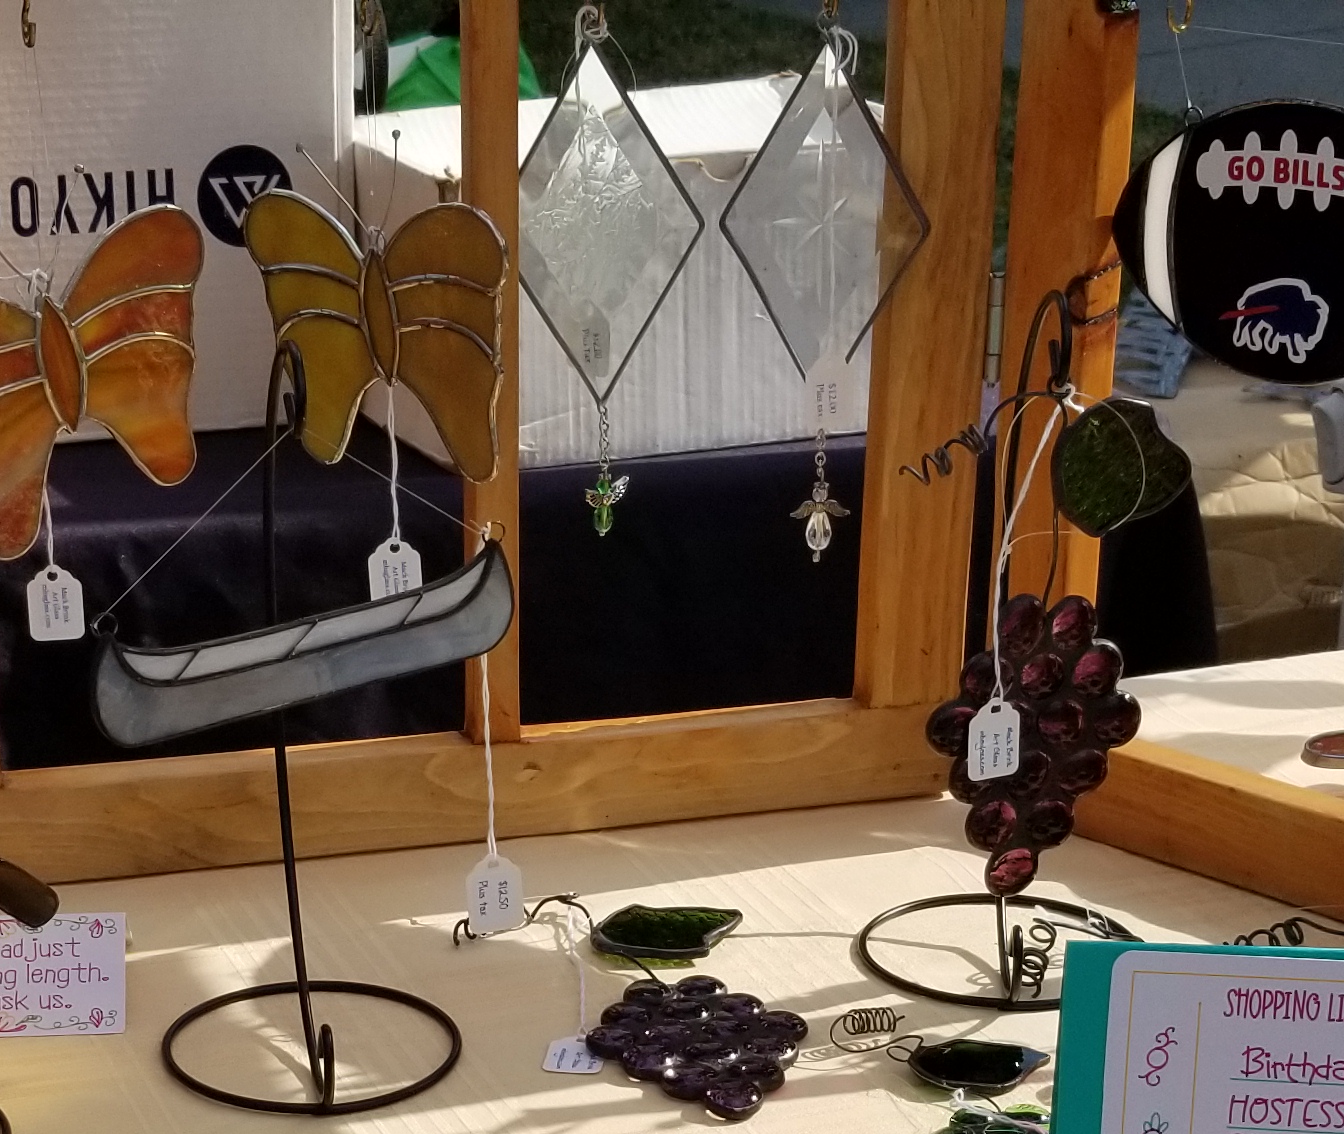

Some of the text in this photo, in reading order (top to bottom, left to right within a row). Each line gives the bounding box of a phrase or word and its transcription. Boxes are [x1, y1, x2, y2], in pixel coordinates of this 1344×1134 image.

[1228, 155, 1265, 182] GO
[478, 880, 488, 899] Plus
[0, 937, 81, 963] adjust
[26, 962, 110, 989] length.
[39, 994, 73, 1010] us.
[1223, 988, 1321, 1023] SHOPPING
